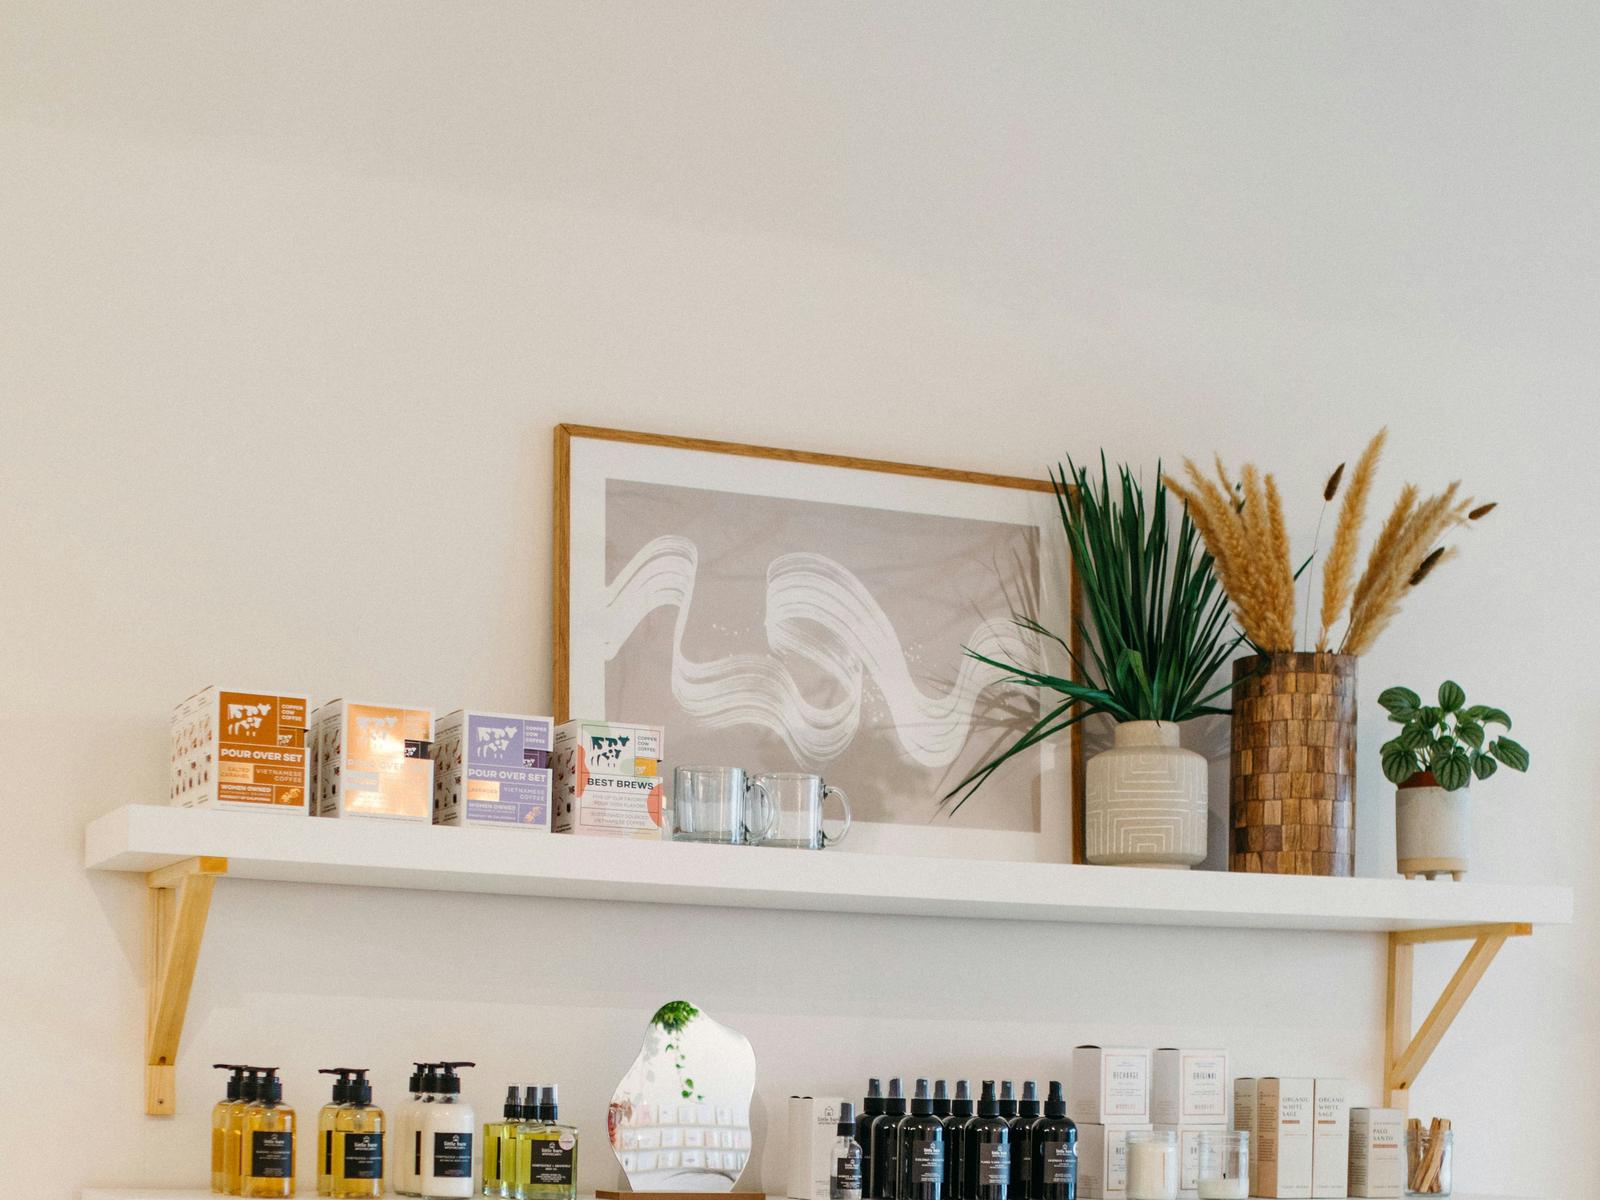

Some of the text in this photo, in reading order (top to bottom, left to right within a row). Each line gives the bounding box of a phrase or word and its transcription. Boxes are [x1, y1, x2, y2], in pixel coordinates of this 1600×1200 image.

[220, 748, 302, 762] POUR OVER SET
[256, 768, 302, 777] VIETNAMESE
[468, 768, 546, 782] POUR OVER SET
[587, 778, 654, 790] BEST BREWS
